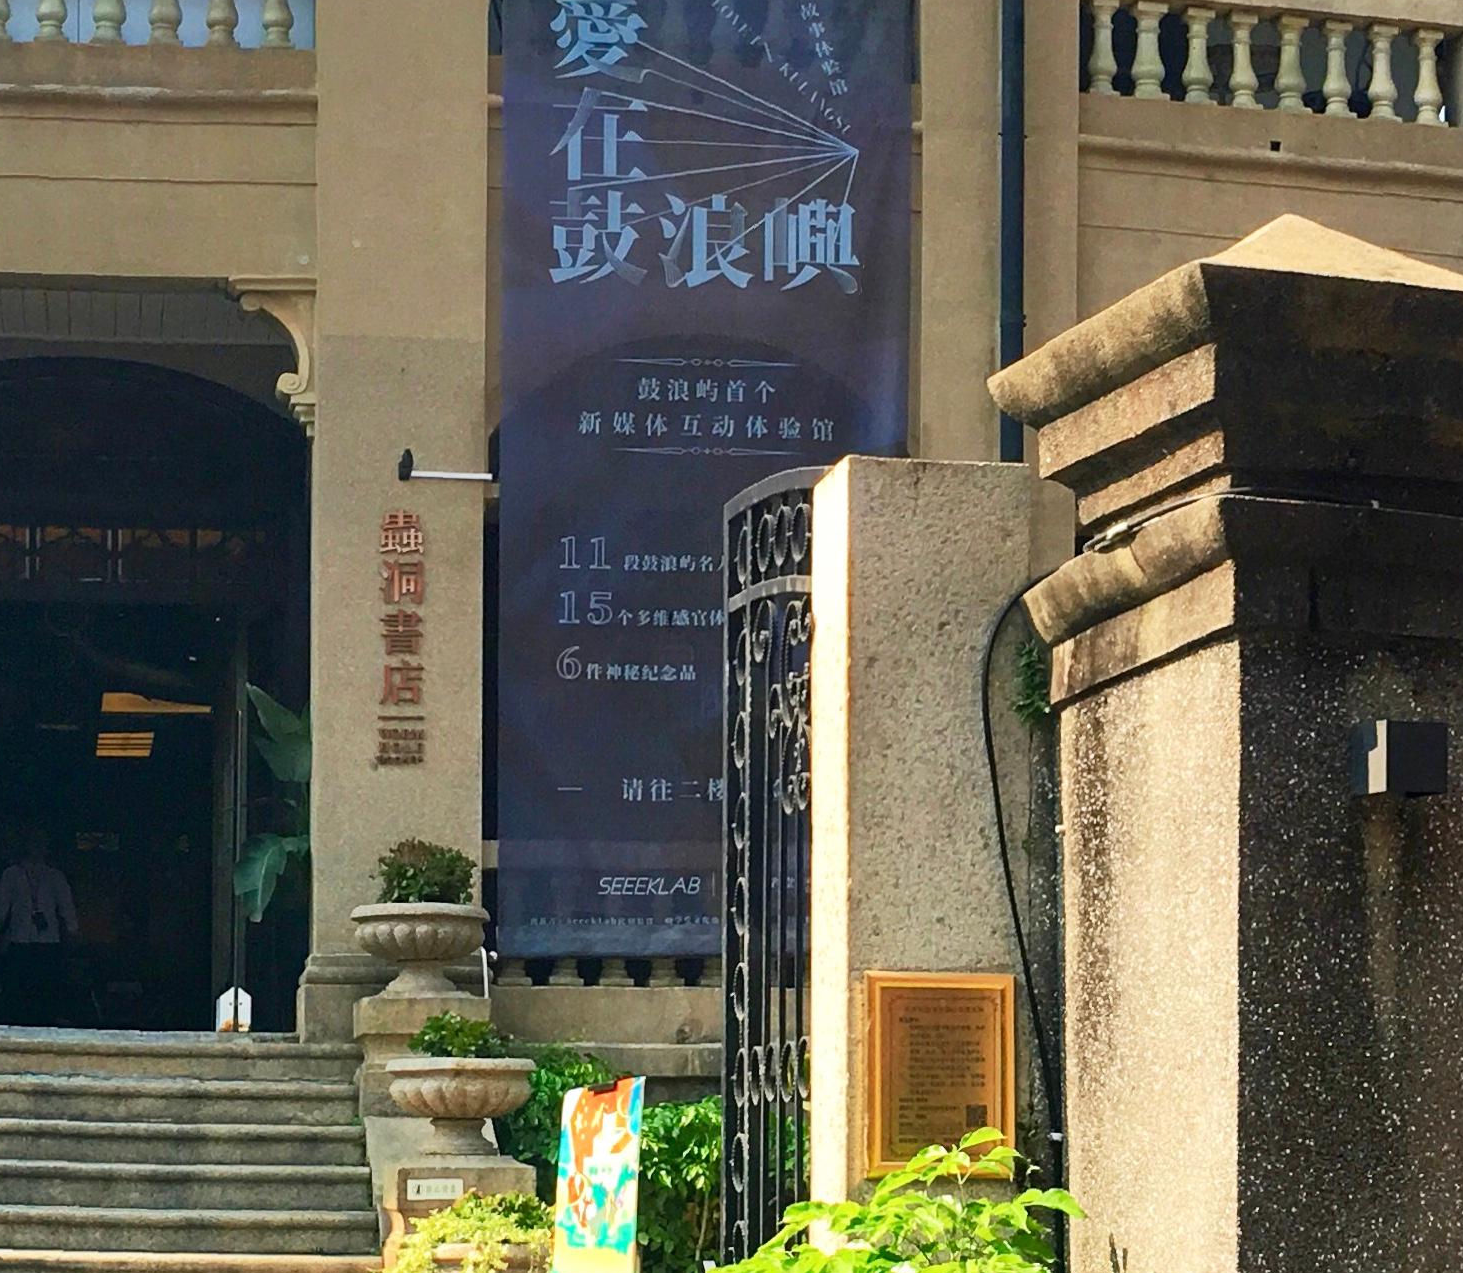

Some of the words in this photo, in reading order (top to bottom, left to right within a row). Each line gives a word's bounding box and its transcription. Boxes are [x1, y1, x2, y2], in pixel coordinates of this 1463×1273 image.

[800, 2, 848, 96] 故事体验馆
[550, 87, 648, 181] 在
[637, 376, 776, 404] 鼓浪屿首个
[578, 411, 835, 442] 新媒体互动体验馆
[559, 535, 611, 569] 11
[379, 508, 425, 706] 蟲洞書店
[598, 877, 700, 895] SEEEKLAB
